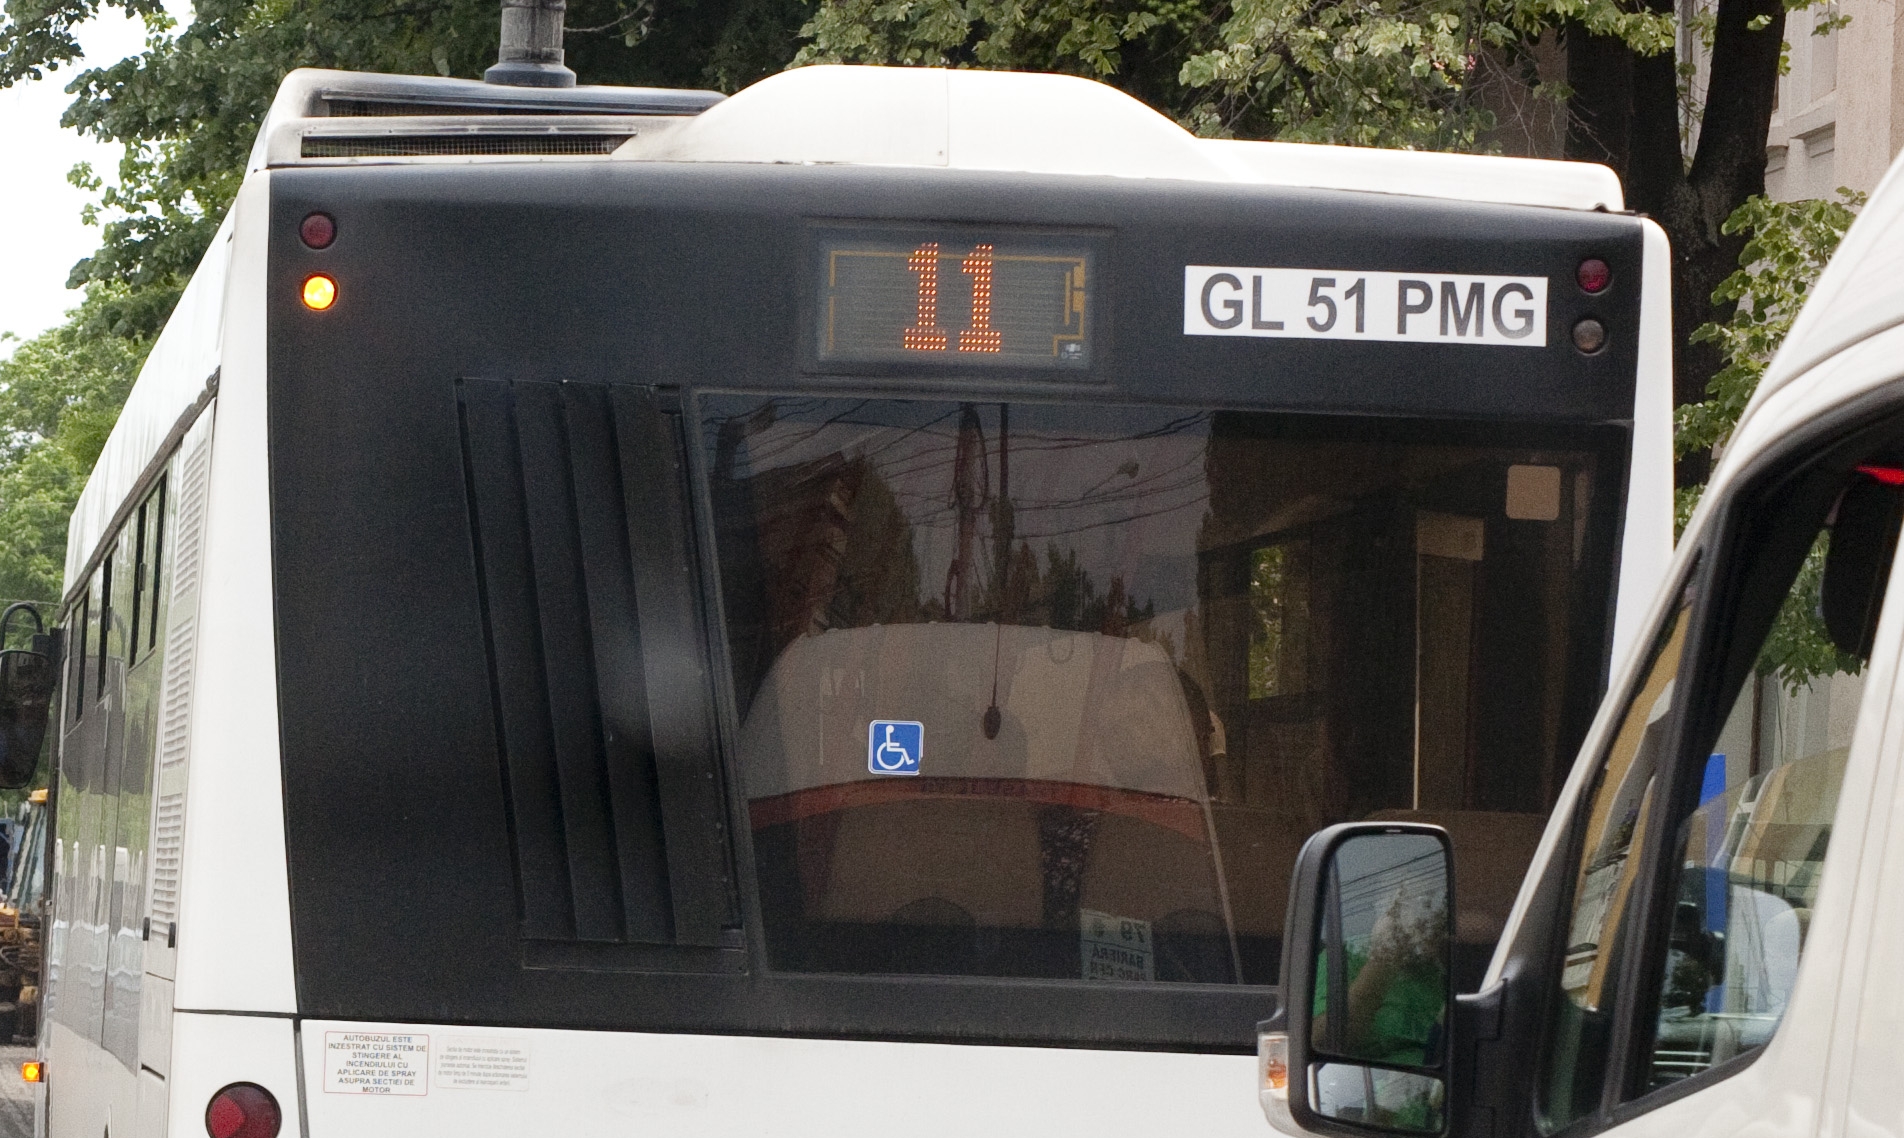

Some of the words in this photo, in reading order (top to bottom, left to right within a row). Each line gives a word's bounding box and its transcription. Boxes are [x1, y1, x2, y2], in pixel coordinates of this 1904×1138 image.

[904, 242, 1001, 352] 11
[1200, 273, 1285, 331] GL
[1306, 277, 1366, 333] 51
[1397, 279, 1534, 340] PMG
[343, 1034, 390, 1043] AUTOBUZUL
[392, 1036, 413, 1044] ESTE
[328, 1042, 371, 1050] INZESTRAT
[372, 1043, 384, 1051] CU
[386, 1044, 414, 1052] SISTEM
[352, 1051, 391, 1060] STINGERE
[346, 1060, 396, 1068] INCENDIULUI
[397, 1061, 409, 1069] CU
[338, 1077, 371, 1085] ASUPRA
[372, 1078, 403, 1086] SECTIEI
